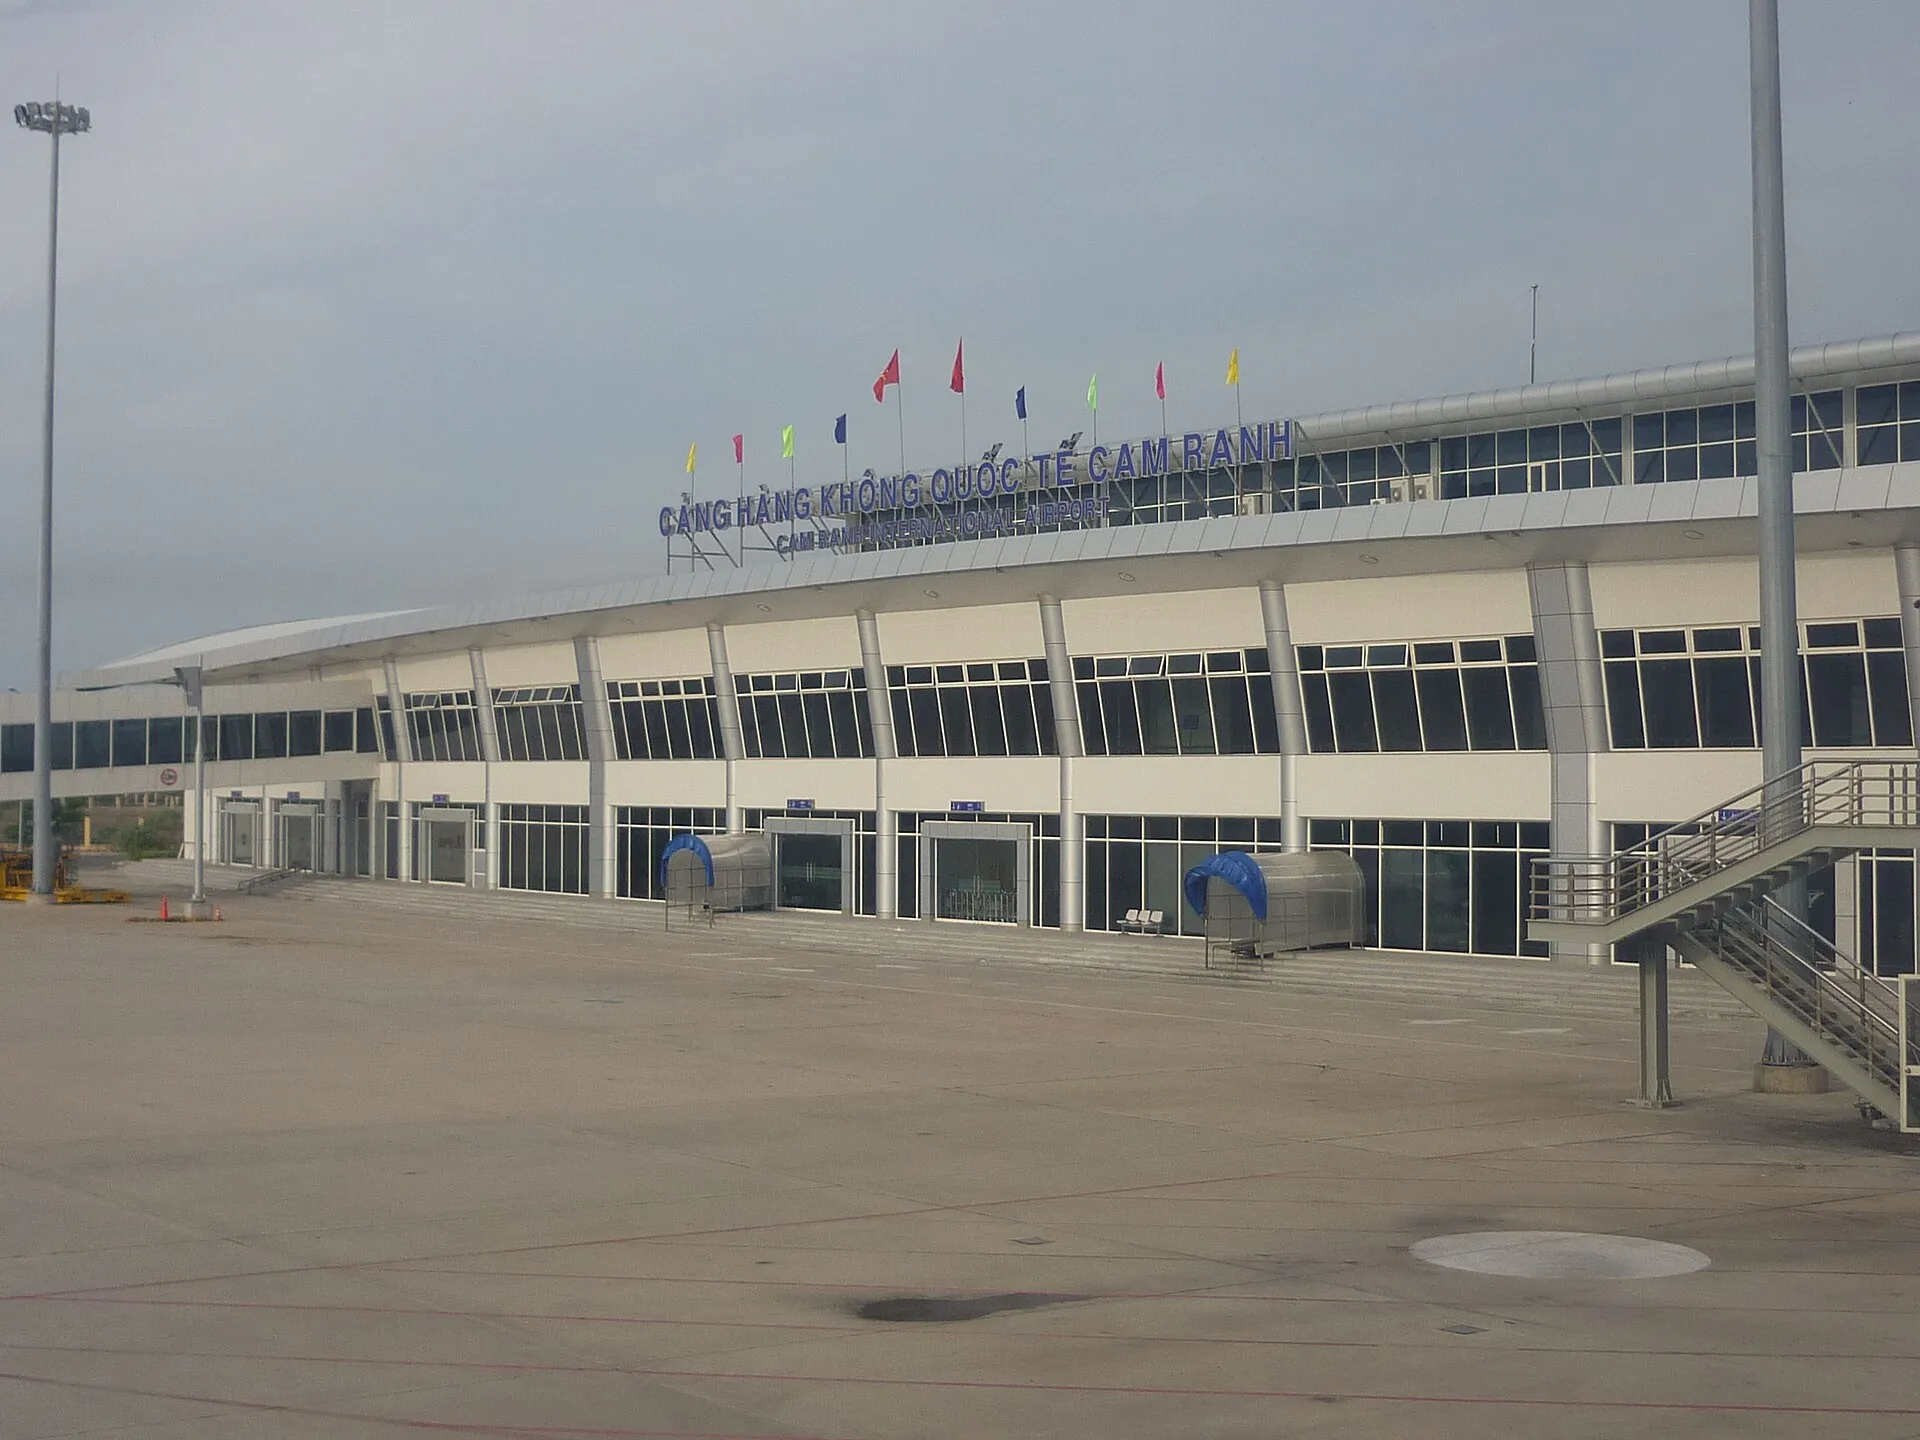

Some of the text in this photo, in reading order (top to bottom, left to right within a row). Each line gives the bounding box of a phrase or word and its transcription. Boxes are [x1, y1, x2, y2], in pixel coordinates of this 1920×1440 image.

[820, 468, 920, 517] KHÔNG
[930, 442, 1020, 503] QUỐC
[1031, 431, 1083, 488] TẾ
[1087, 437, 1168, 484] CAM
[1183, 419, 1292, 472] RANH
[776, 495, 1110, 554] CAM RANH INTERNATIONAL AIRPORT
